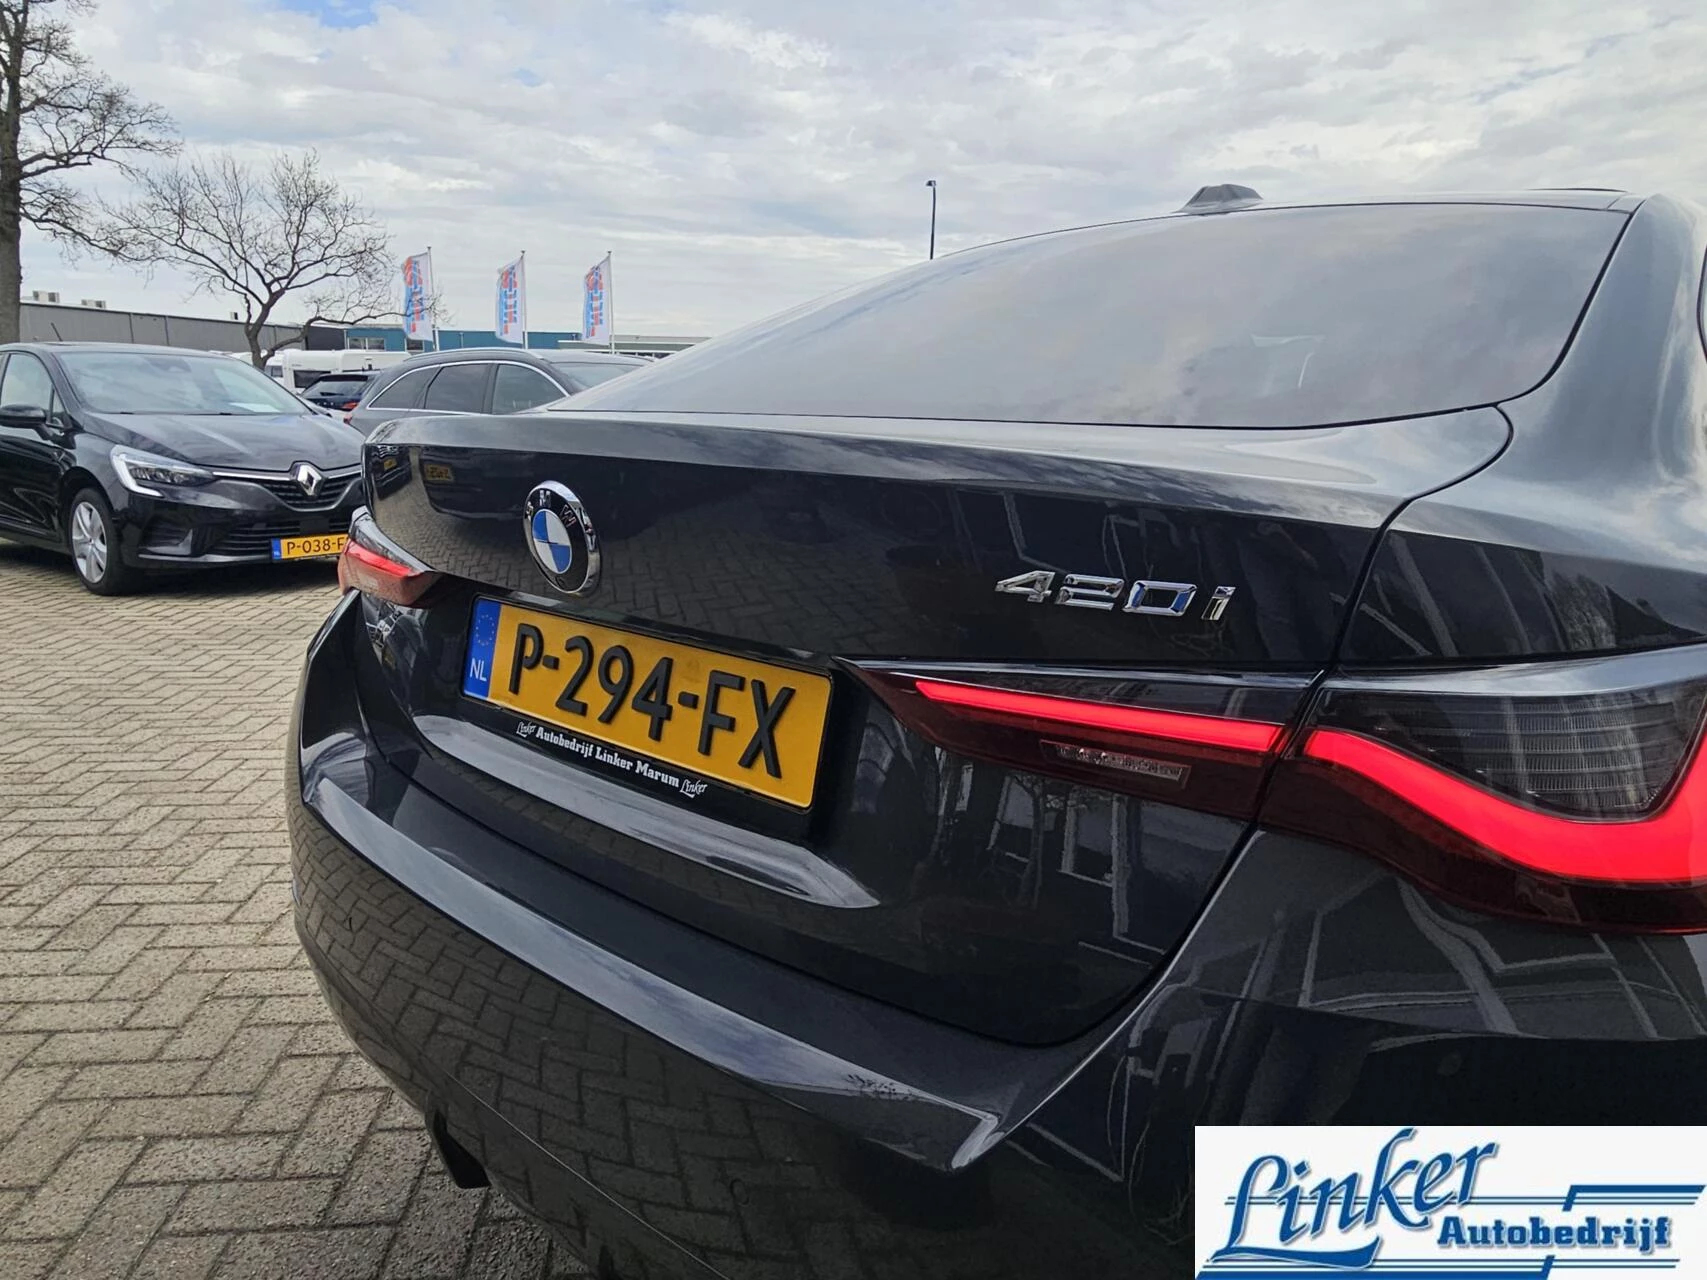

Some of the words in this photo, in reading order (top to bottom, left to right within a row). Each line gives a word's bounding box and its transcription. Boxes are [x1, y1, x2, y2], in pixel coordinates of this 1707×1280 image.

[286, 536, 349, 555] P-038-F
[995, 570, 1236, 620] 420i
[469, 657, 487, 681] NL
[508, 622, 796, 779] P-294-FX
[536, 726, 593, 758] Autobedrijf
[595, 747, 633, 771] Linker
[635, 760, 679, 788] Marum
[680, 778, 708, 798] Linker
